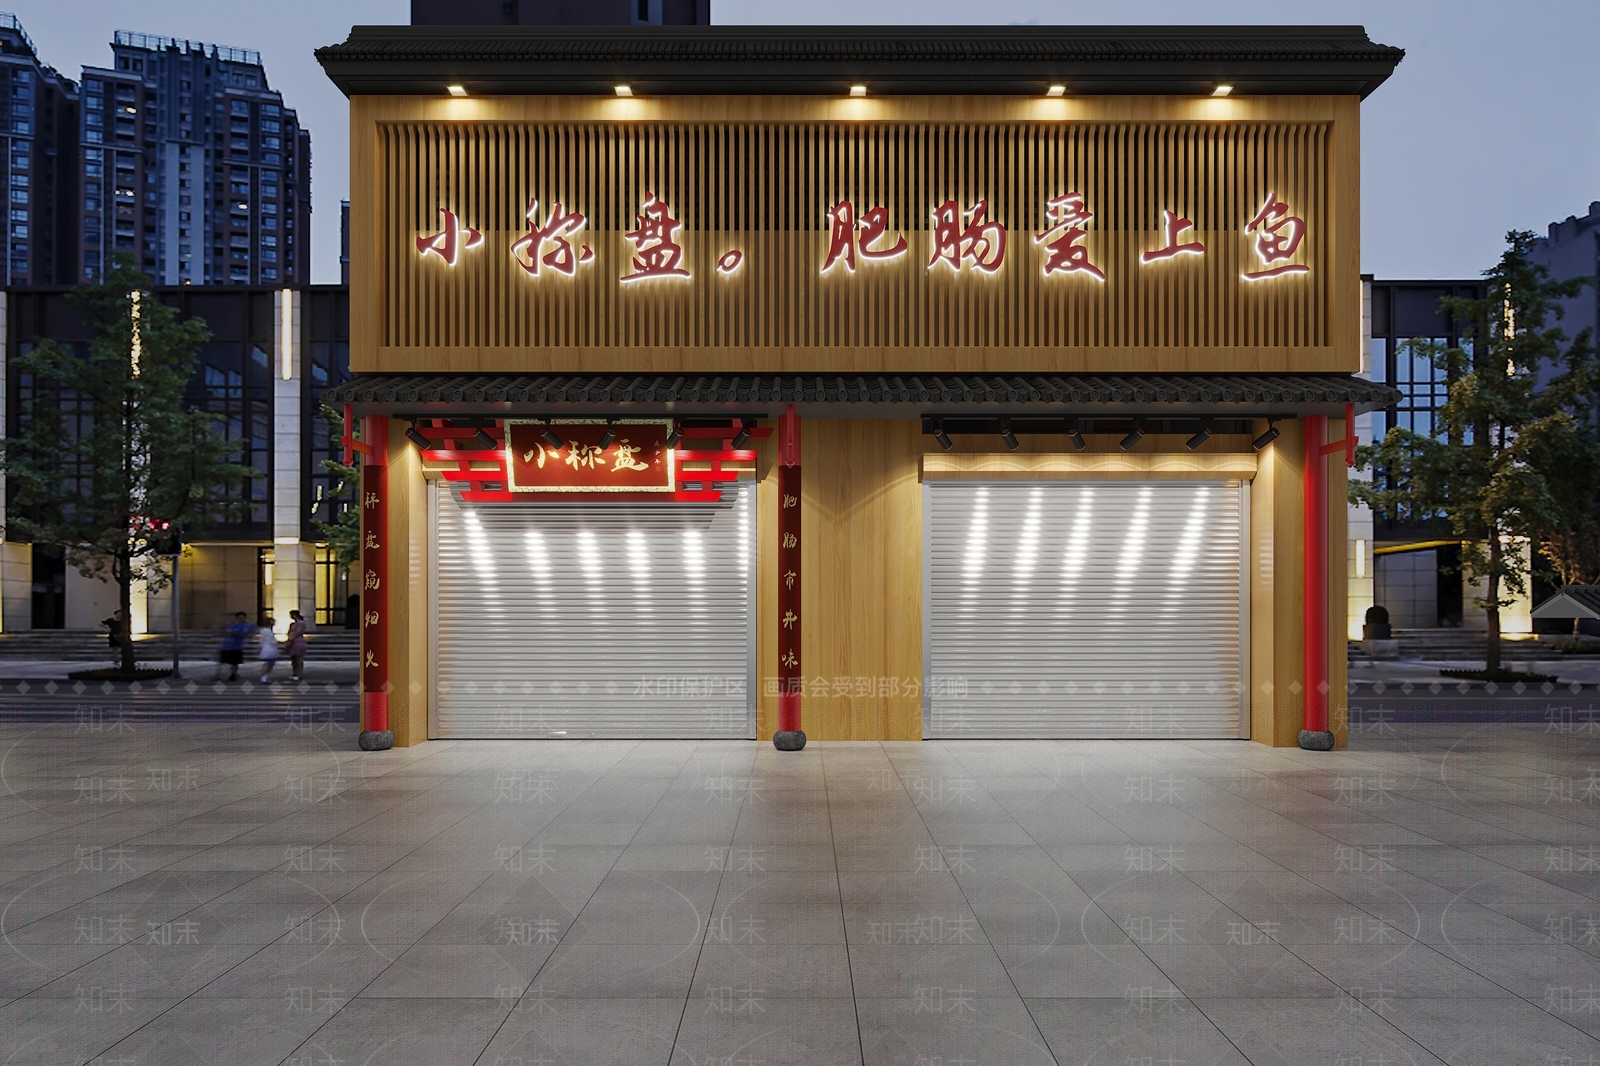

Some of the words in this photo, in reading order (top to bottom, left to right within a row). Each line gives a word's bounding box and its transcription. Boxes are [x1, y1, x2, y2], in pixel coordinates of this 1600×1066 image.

[781, 493, 799, 670] 肥肠市井味
